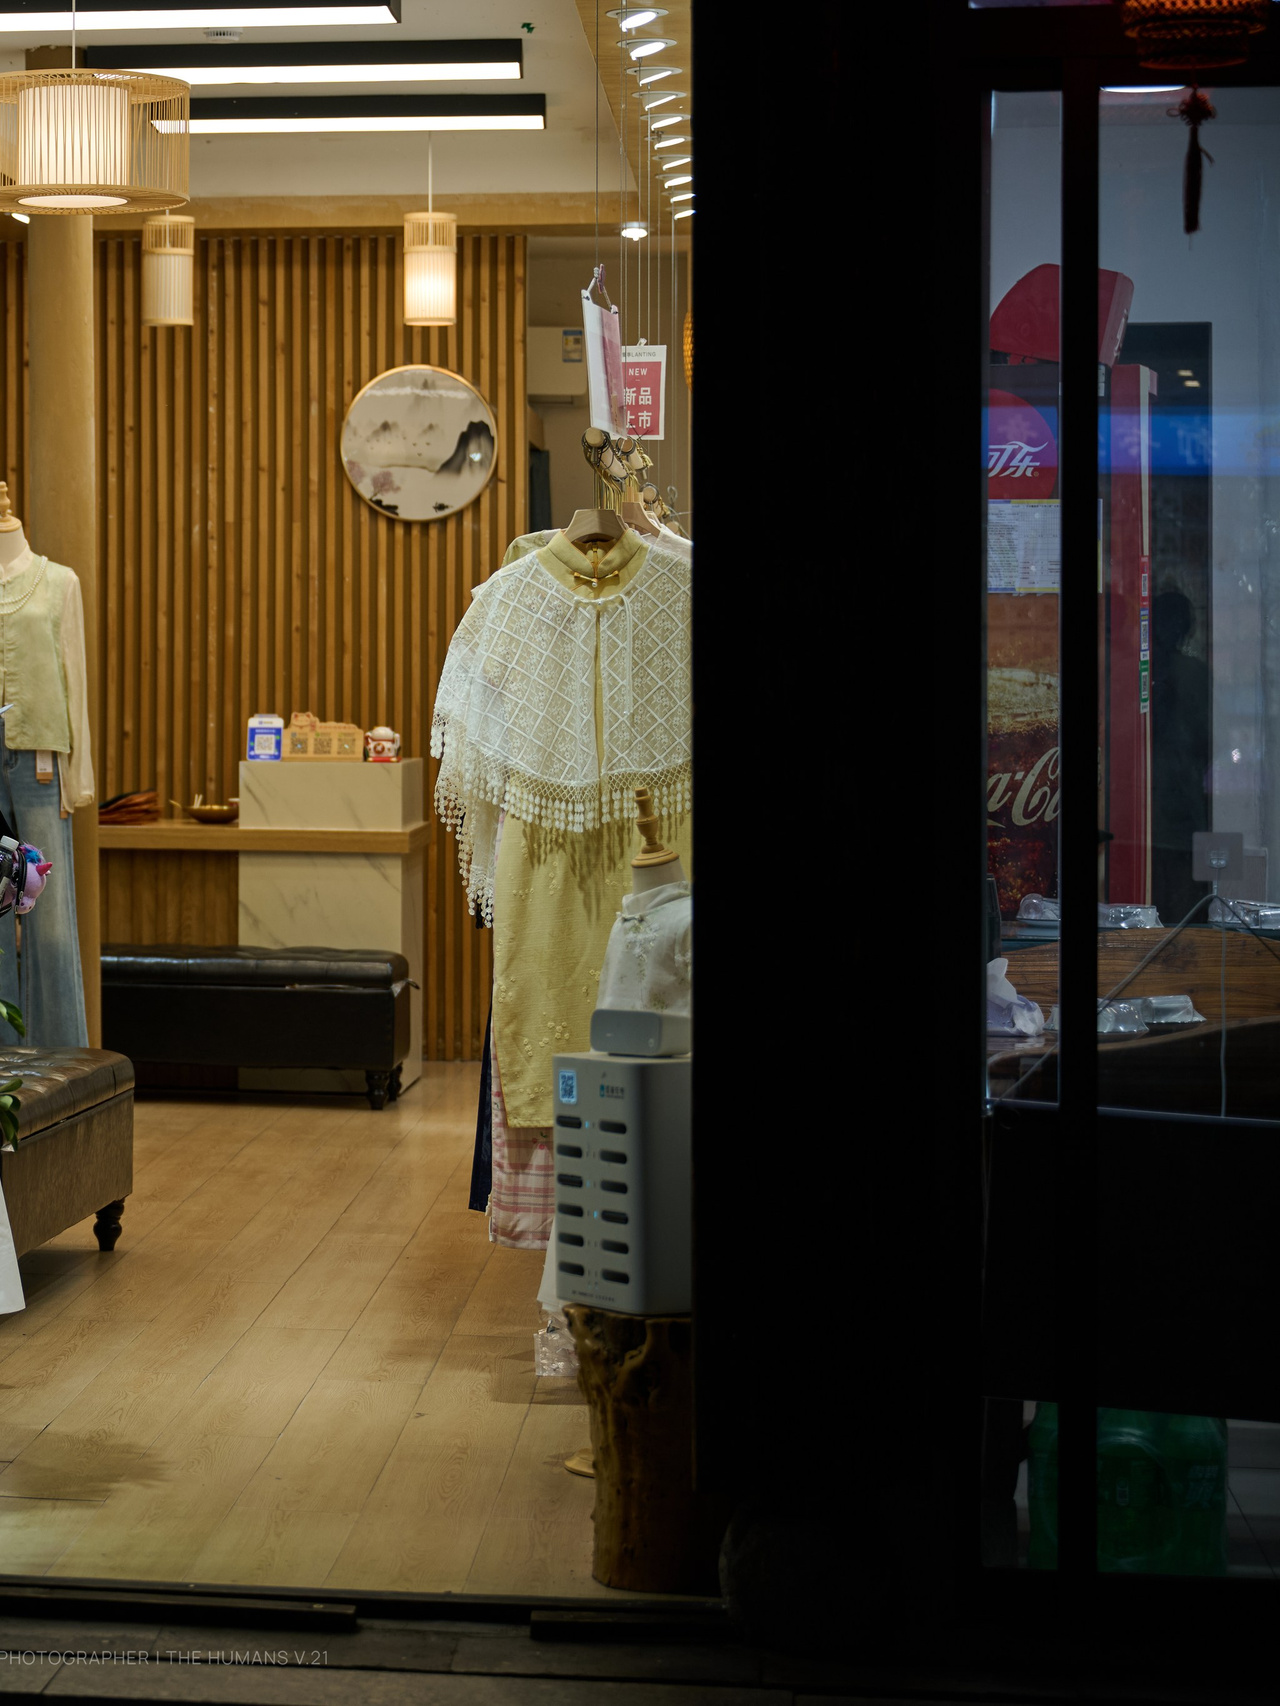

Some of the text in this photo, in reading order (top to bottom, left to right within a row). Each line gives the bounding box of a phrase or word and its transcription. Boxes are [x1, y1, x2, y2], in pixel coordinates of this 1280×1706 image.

[628, 367, 648, 376] NEW
[624, 386, 652, 406] 新品
[626, 410, 652, 429] 上市
